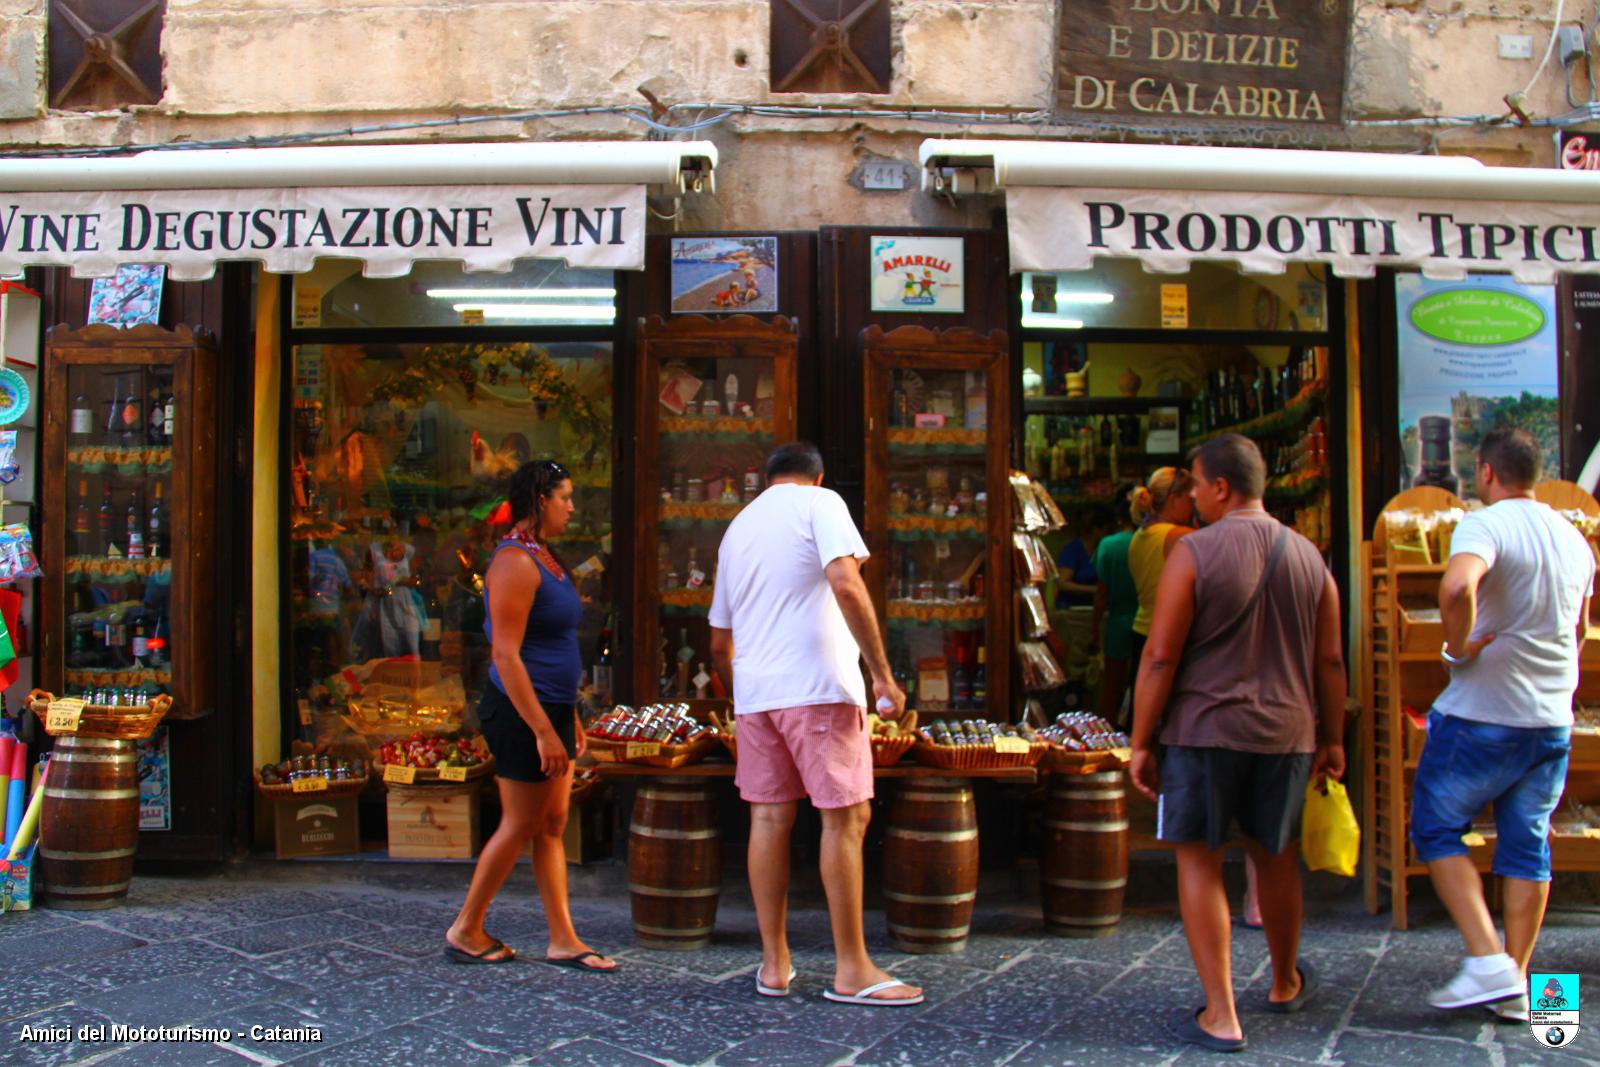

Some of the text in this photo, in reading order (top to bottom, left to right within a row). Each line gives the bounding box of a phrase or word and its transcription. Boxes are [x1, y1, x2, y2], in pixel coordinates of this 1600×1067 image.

[1107, 24, 1299, 69] E DELIZIE
[1072, 75, 1326, 121] DI CALABRIA
[873, 167, 895, 185] 41
[118, 203, 493, 251] DEGUSTAZIONE
[516, 197, 627, 246] VINI
[1083, 201, 1600, 263] PRODOTTI TIPICI
[883, 255, 952, 273] AMARELLI
